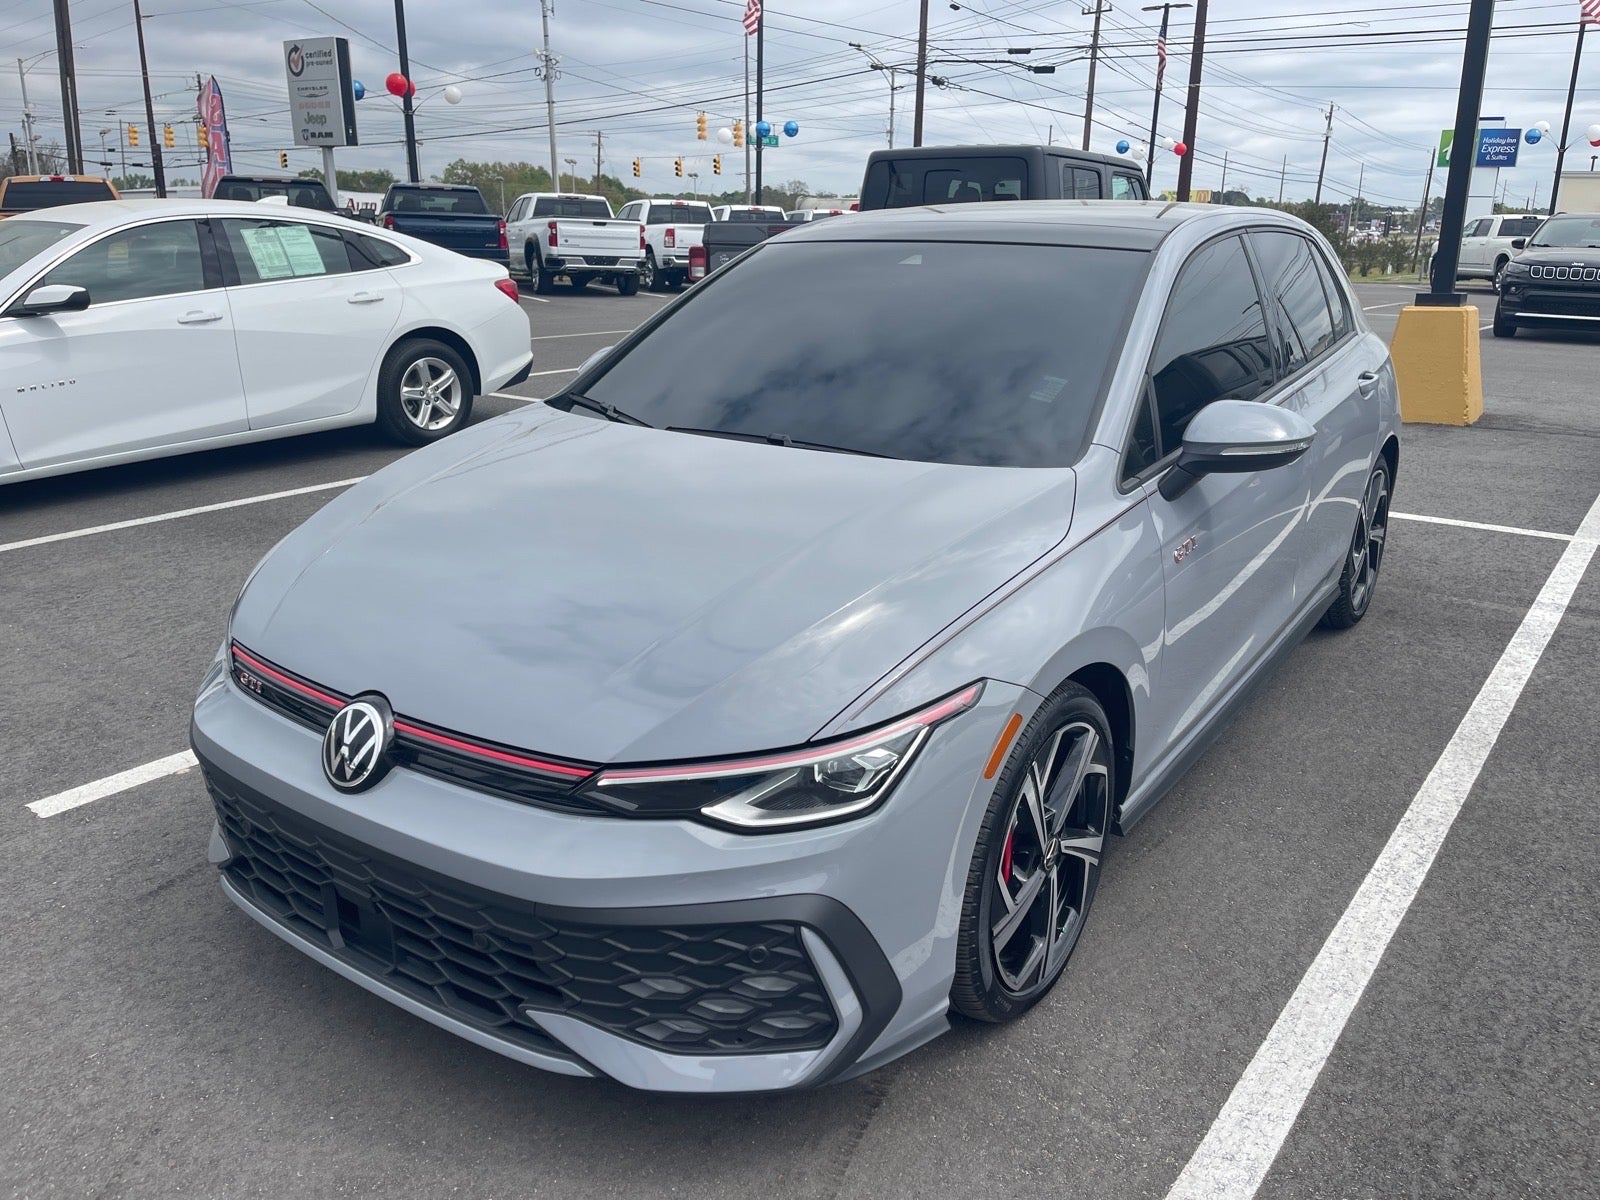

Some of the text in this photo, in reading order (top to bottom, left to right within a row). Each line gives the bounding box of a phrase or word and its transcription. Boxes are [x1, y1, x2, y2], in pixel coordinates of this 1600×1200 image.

[305, 49, 332, 58] certified
[304, 111, 327, 126] Jeep
[310, 131, 334, 139] RAM
[1481, 145, 1515, 154] Express
[17, 378, 75, 392] MALIBU
[1173, 534, 1198, 564] GTI
[240, 672, 262, 693] GTI
